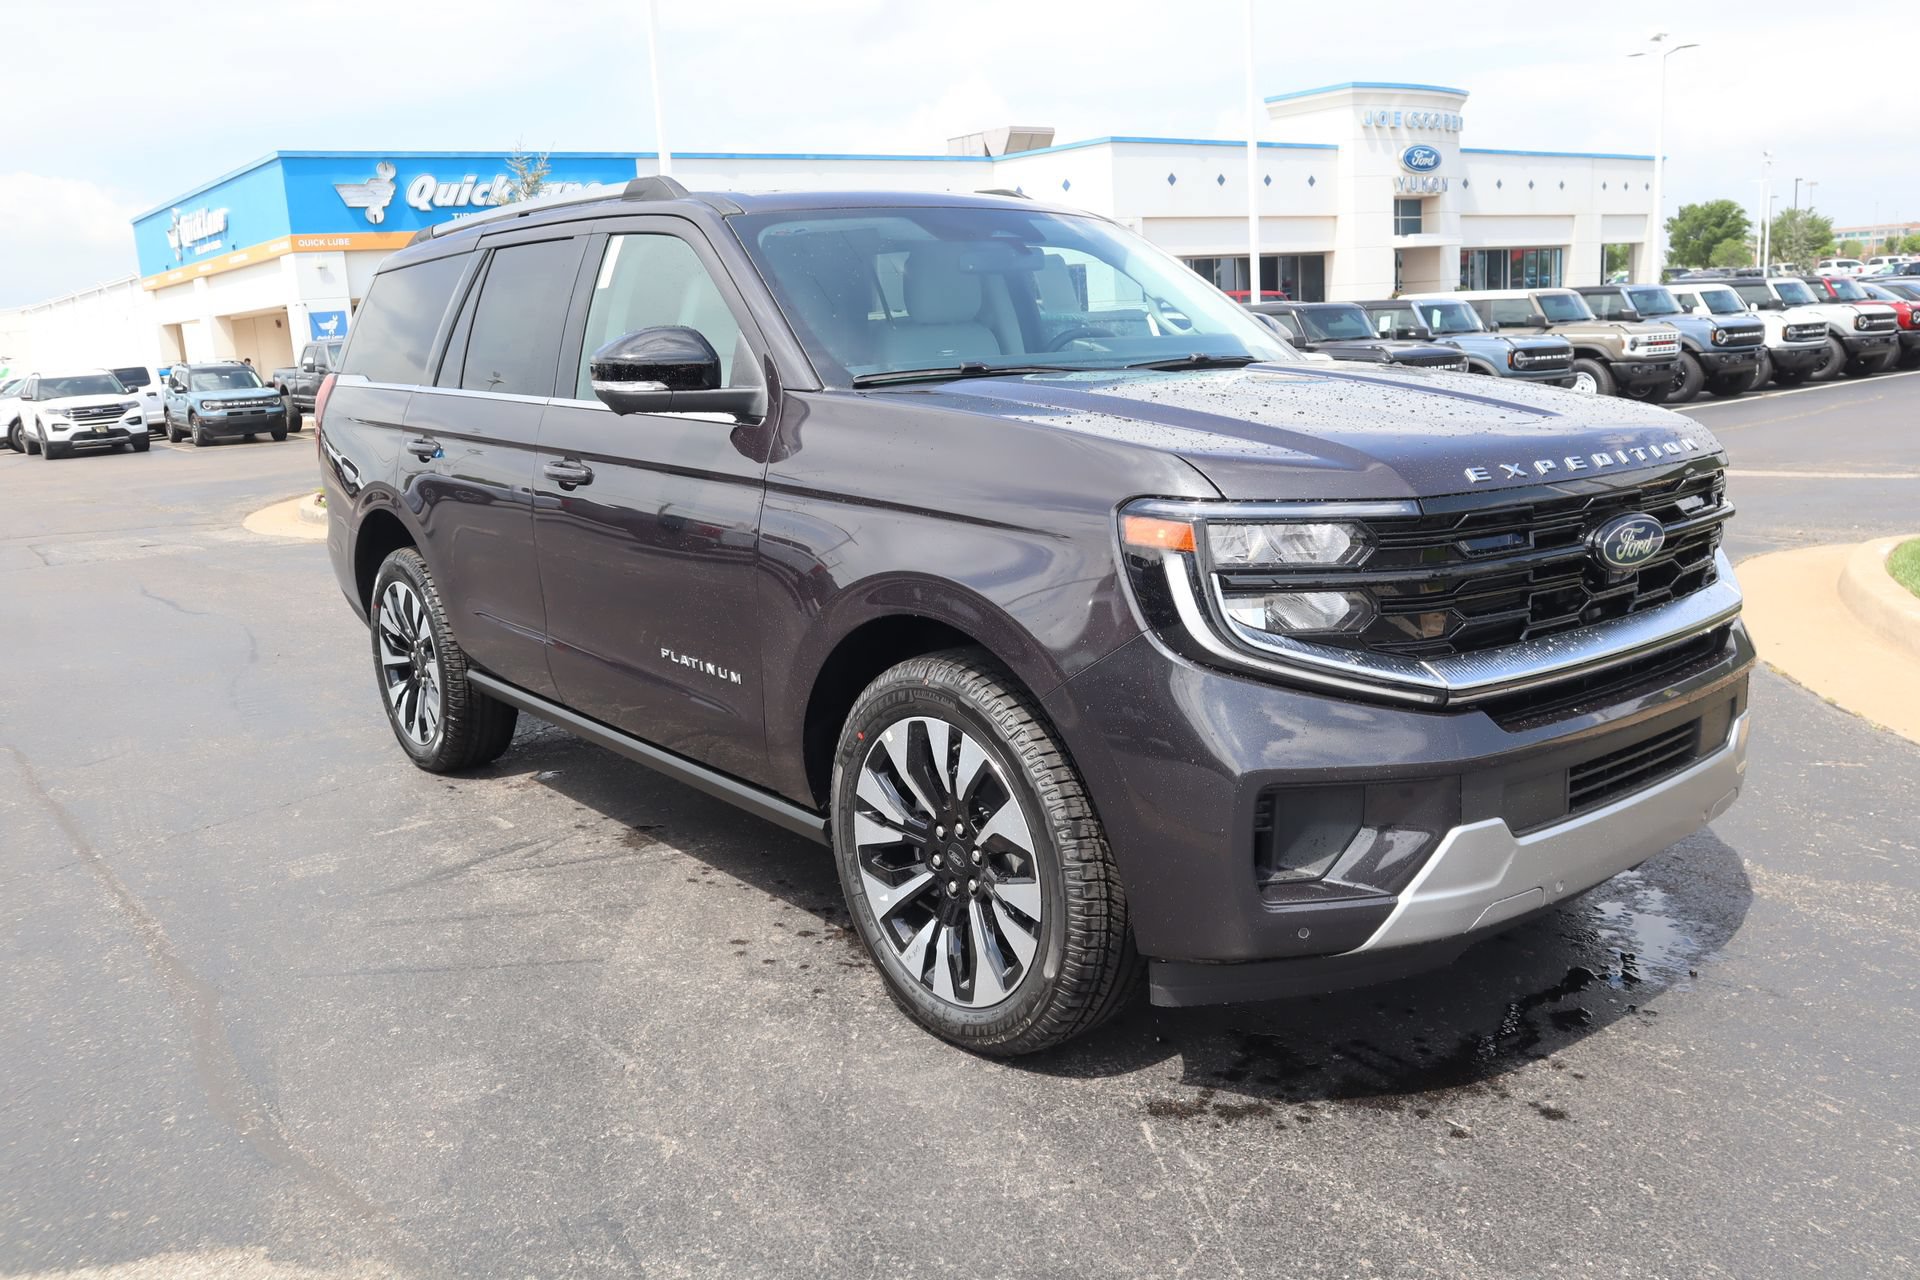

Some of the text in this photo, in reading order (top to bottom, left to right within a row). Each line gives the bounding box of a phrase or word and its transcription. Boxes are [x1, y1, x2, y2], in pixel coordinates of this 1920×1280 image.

[1363, 111, 1402, 128] JOE
[1411, 149, 1436, 166] Ford
[405, 173, 516, 211] Quick
[1397, 175, 1449, 192] YUKON
[298, 239, 326, 247] QUICK
[327, 238, 351, 246] LUBE
[1465, 438, 1699, 483] EXPEDITION
[1616, 526, 1655, 559] Ford
[661, 647, 741, 685] PLATINUM
